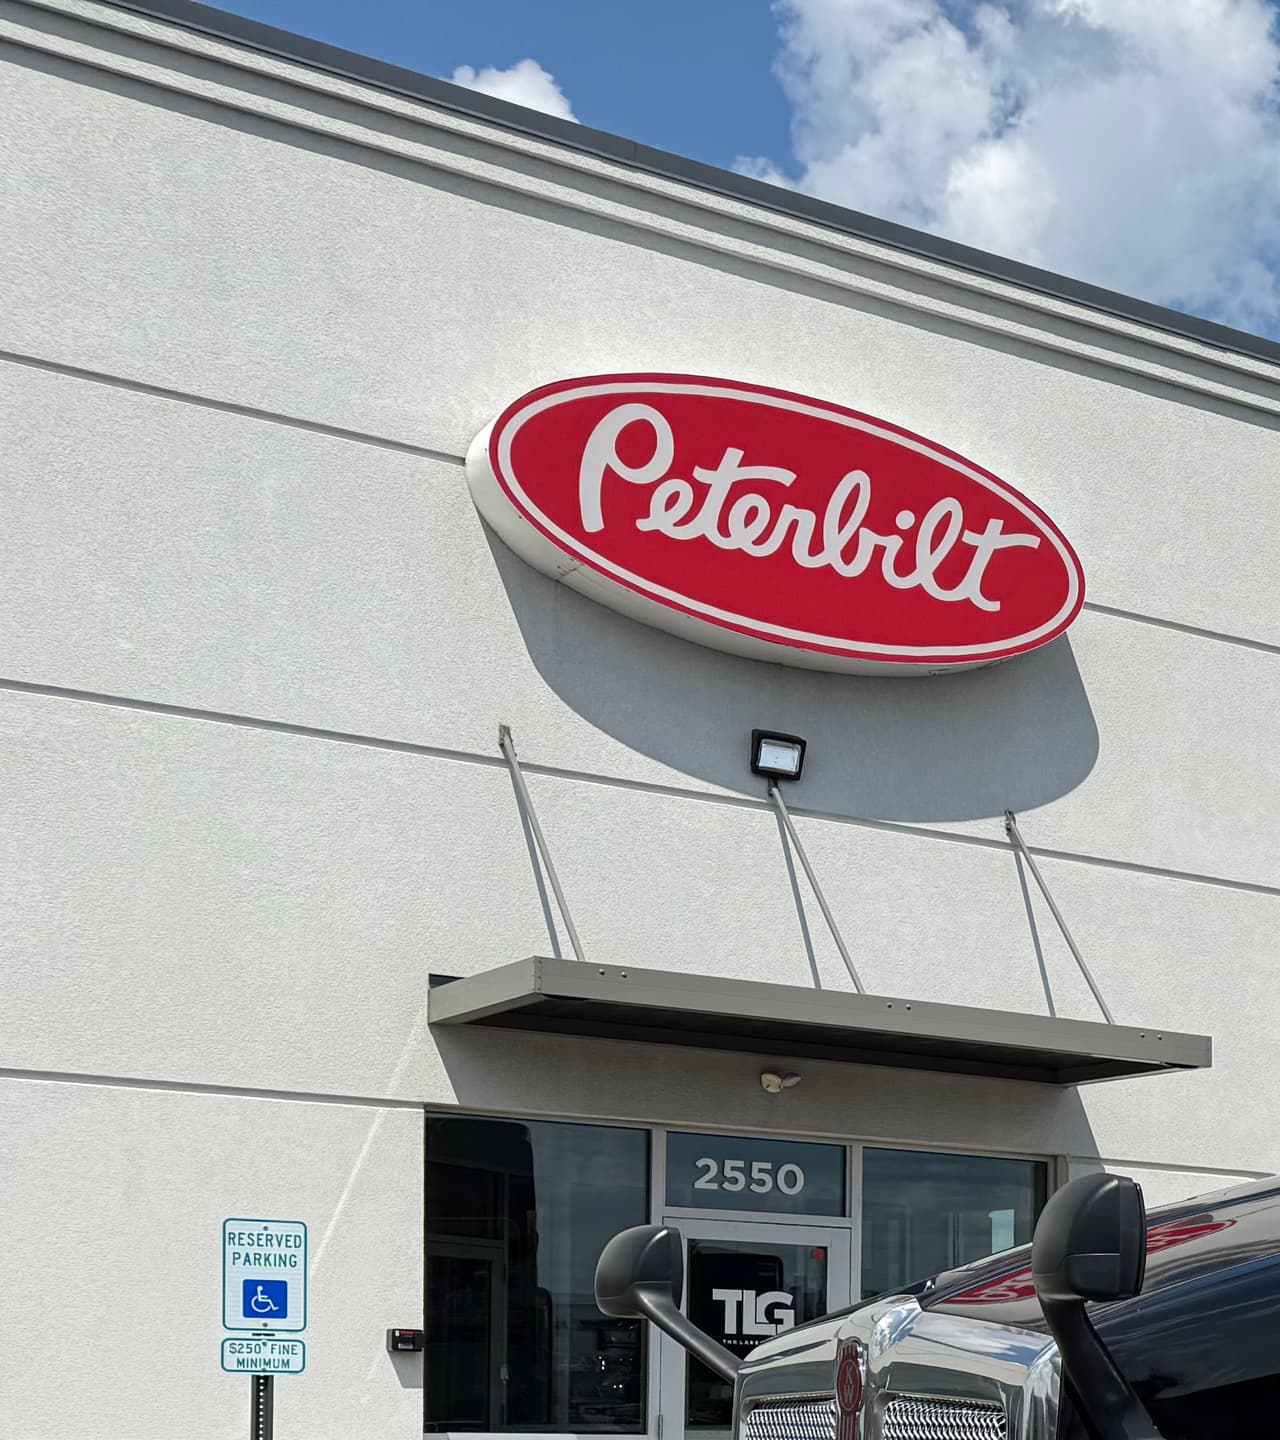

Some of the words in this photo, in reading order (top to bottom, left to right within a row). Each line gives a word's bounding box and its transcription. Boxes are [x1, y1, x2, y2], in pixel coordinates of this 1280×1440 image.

[579, 402, 1041, 612] Peterbilt
[693, 1157, 805, 1195] 2550
[228, 1232, 302, 1249] RESERVED
[232, 1252, 297, 1268] PARKING
[712, 1288, 795, 1336] TLG
[271, 1344, 298, 1356] FINE
[237, 1358, 290, 1369] MINIMUM
